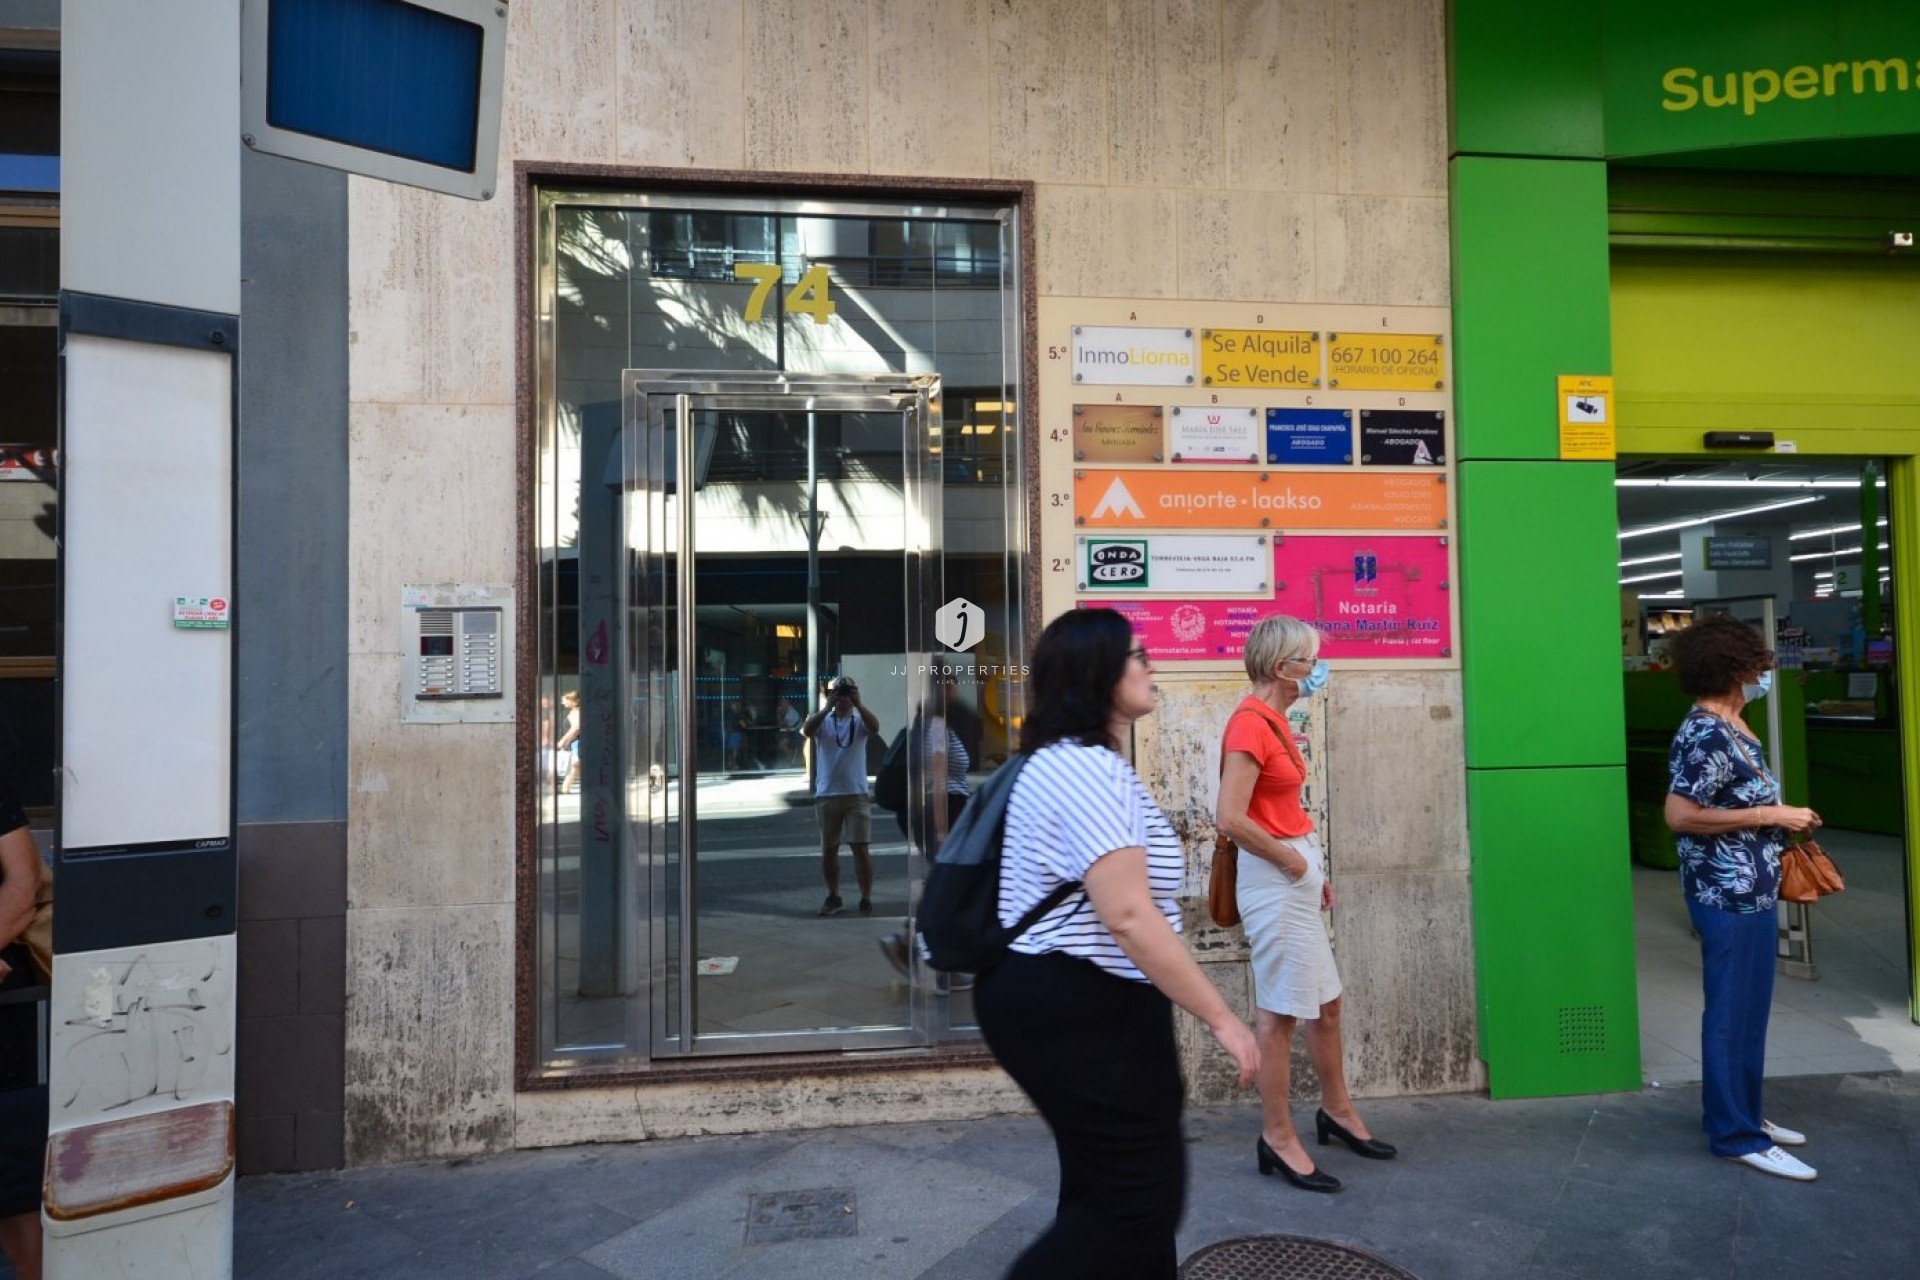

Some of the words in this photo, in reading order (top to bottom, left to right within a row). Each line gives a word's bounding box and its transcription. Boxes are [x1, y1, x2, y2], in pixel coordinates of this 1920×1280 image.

[1662, 58, 1920, 116] Superm
[734, 263, 836, 325] 74
[1129, 311, 1137, 321] A
[1382, 317, 1388, 327] E
[1212, 334, 1236, 353] Se
[1242, 334, 1312, 358] Alquila
[1078, 345, 1190, 366] InmoLiorna
[1331, 347, 1363, 363] 667
[1371, 348, 1401, 364] 100
[1407, 349, 1438, 365] 264
[1217, 363, 1240, 382] Se
[1245, 365, 1309, 383] Vende
[1382, 366, 1394, 375] DE
[1116, 393, 1122, 401] A
[1211, 394, 1218, 404] B
[1306, 395, 1312, 406] C
[1399, 397, 1406, 406] D
[1252, 487, 1322, 509] laakso
[1097, 550, 1138, 560] ONDA
[1100, 567, 1138, 577] CERO
[1837, 572, 1847, 585] 2
[1339, 601, 1398, 614] Notaría
[1407, 618, 1438, 631] Ruiz
